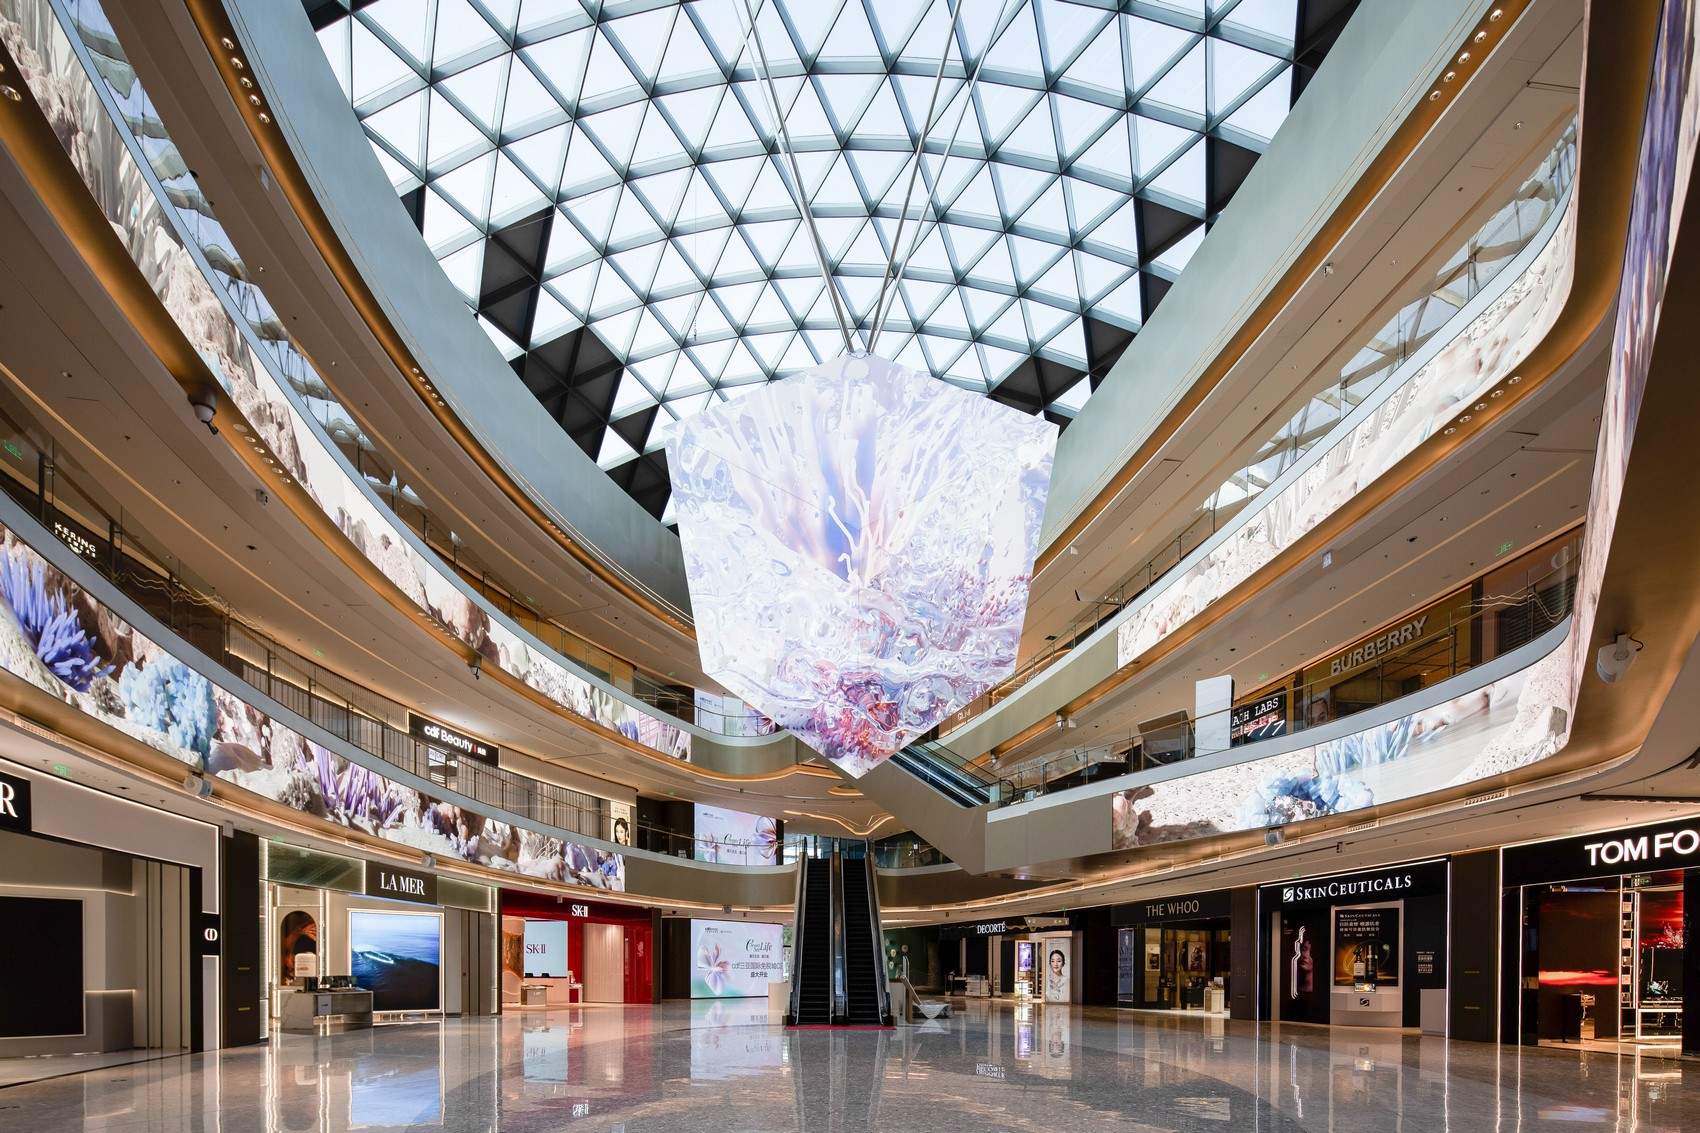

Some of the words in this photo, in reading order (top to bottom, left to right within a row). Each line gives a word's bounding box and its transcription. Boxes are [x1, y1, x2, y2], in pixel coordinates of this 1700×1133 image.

[55, 521, 96, 553] KERING
[1331, 615, 1428, 676] BURBERRY
[1254, 697, 1279, 716] LABS
[424, 725, 440, 739] cdf
[440, 729, 473, 753] Beauty
[1584, 836, 1648, 866] TOM
[380, 872, 397, 891] LA
[399, 876, 426, 896] MER
[1296, 875, 1412, 901] SKINCEUTICALS
[1146, 903, 1165, 917] THE
[1167, 900, 1200, 915] WHOO
